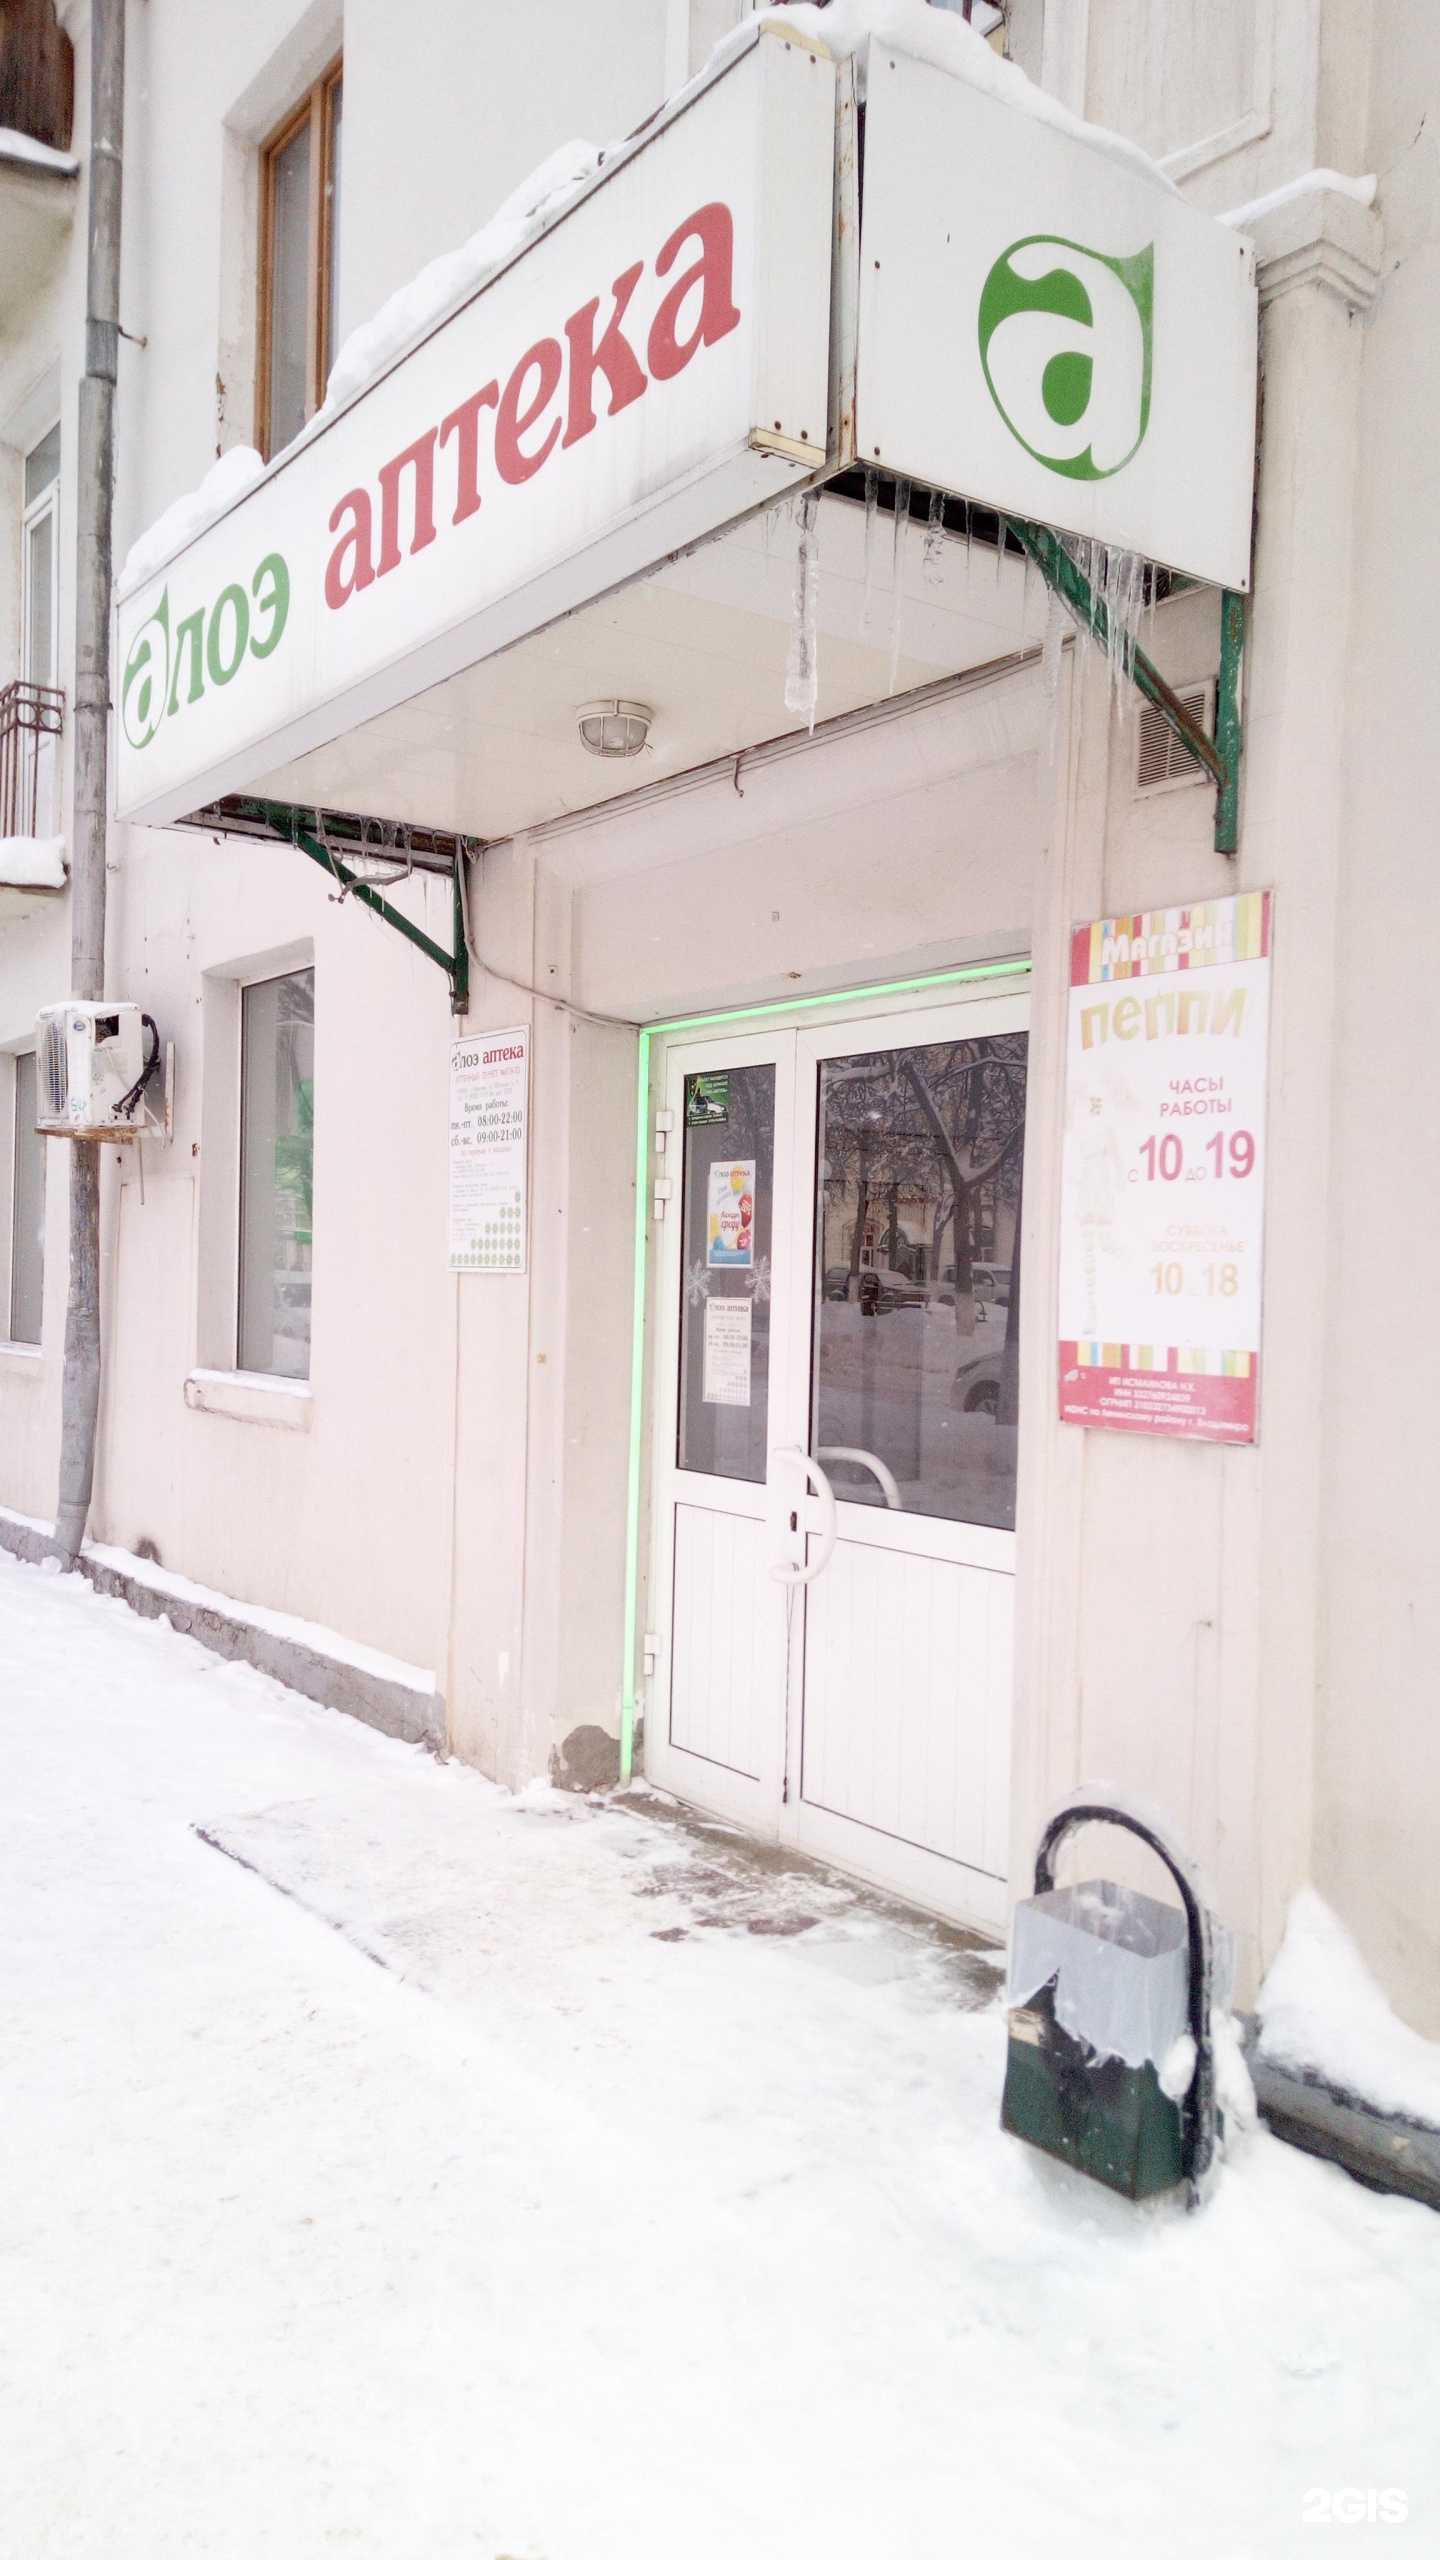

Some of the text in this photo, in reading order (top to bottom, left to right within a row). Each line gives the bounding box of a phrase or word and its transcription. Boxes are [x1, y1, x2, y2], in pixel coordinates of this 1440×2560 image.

[324, 202, 741, 610] аптека
[482, 1045, 524, 1064] аптека
[1168, 1076, 1224, 1094] ЧАСЫ
[1159, 1098, 1232, 1117] РАБОТЫ
[1139, 1133, 1183, 1181] 10
[1205, 1130, 1255, 1179] 19
